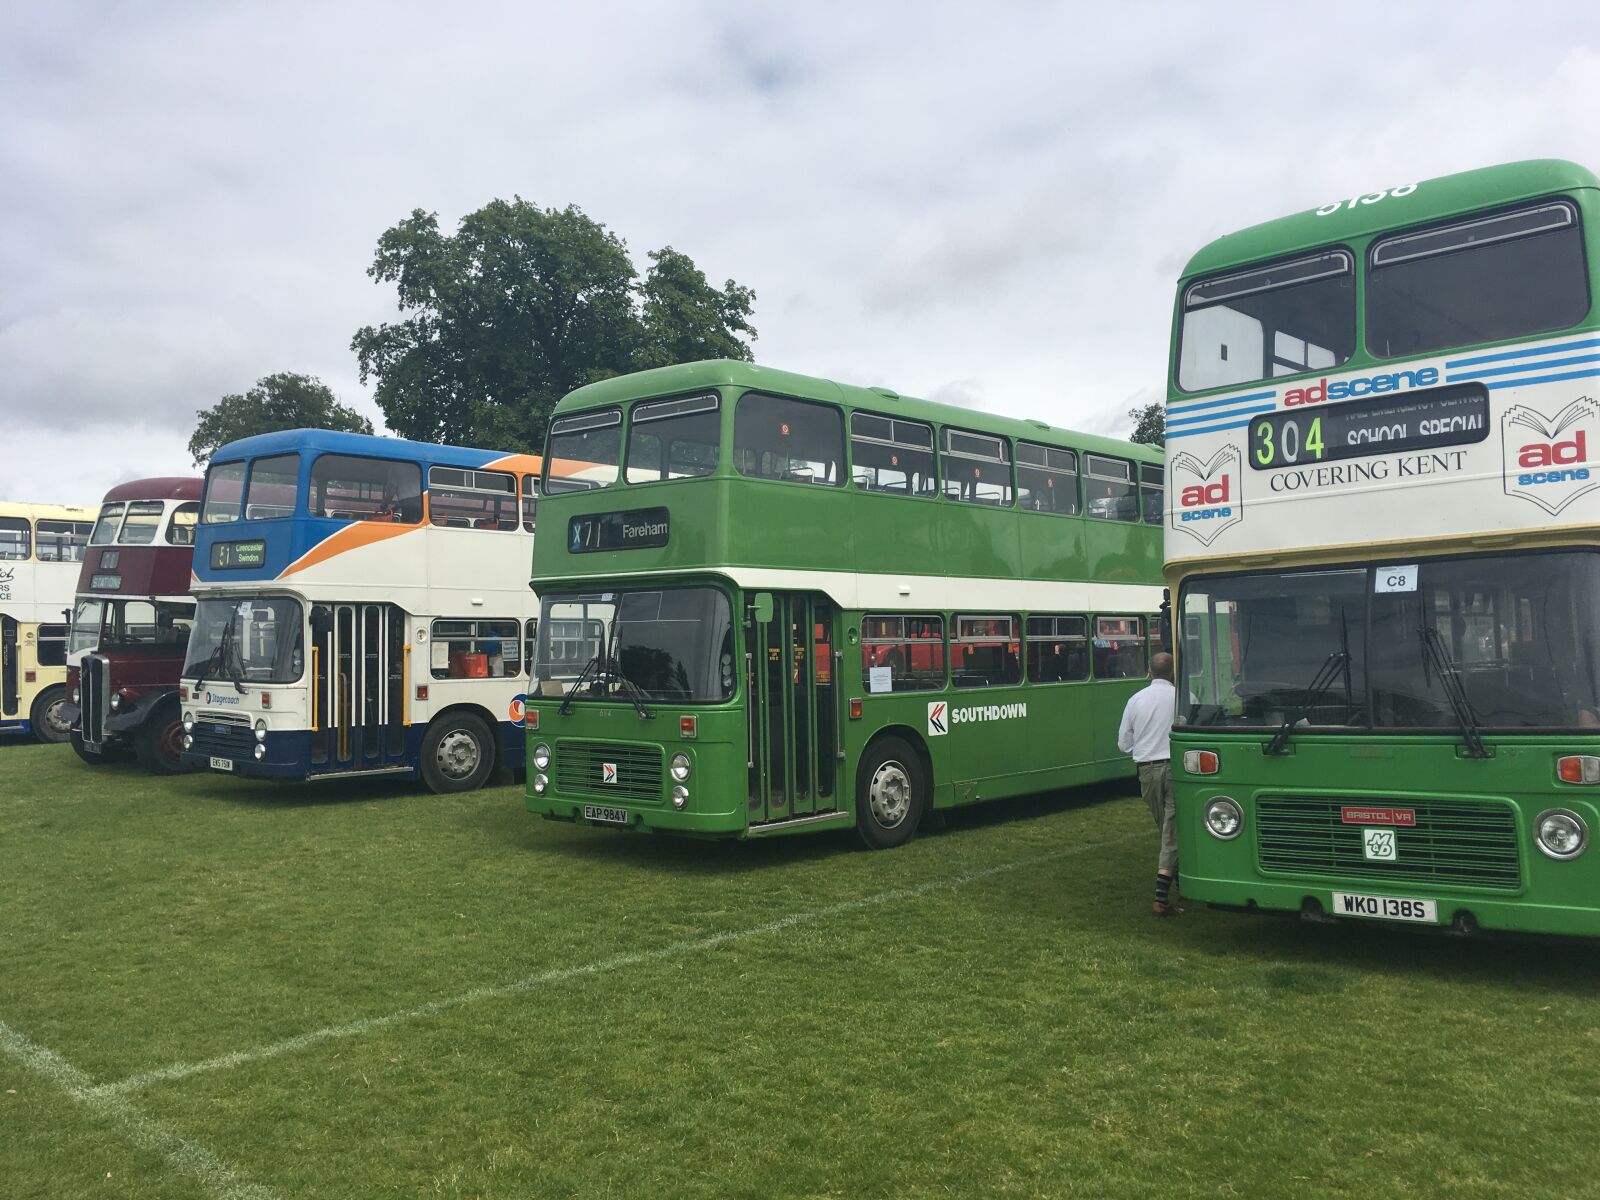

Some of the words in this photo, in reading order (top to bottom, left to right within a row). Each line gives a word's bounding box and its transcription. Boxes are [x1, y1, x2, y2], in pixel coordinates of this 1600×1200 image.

[1284, 366, 1439, 407] adscene
[1256, 416, 1325, 465] 304
[1518, 430, 1587, 468] ad
[1270, 460, 1390, 492] COVERING
[1398, 450, 1468, 477] KENT
[1518, 468, 1590, 486] scene
[1181, 474, 1230, 507] ad
[1181, 507, 1232, 522] scene
[622, 521, 668, 539] Fareham
[238, 553, 259, 562] Swindon
[1386, 575, 1406, 587] C8
[211, 693, 240, 705] Stagecoach
[951, 702, 1027, 724] SOUTHDOWN
[585, 806, 602, 818] EAP
[603, 809, 627, 822] 984V
[1346, 811, 1391, 820] BRISTOL
[1343, 895, 1378, 914] WKO
[1383, 898, 1425, 918] 138S
